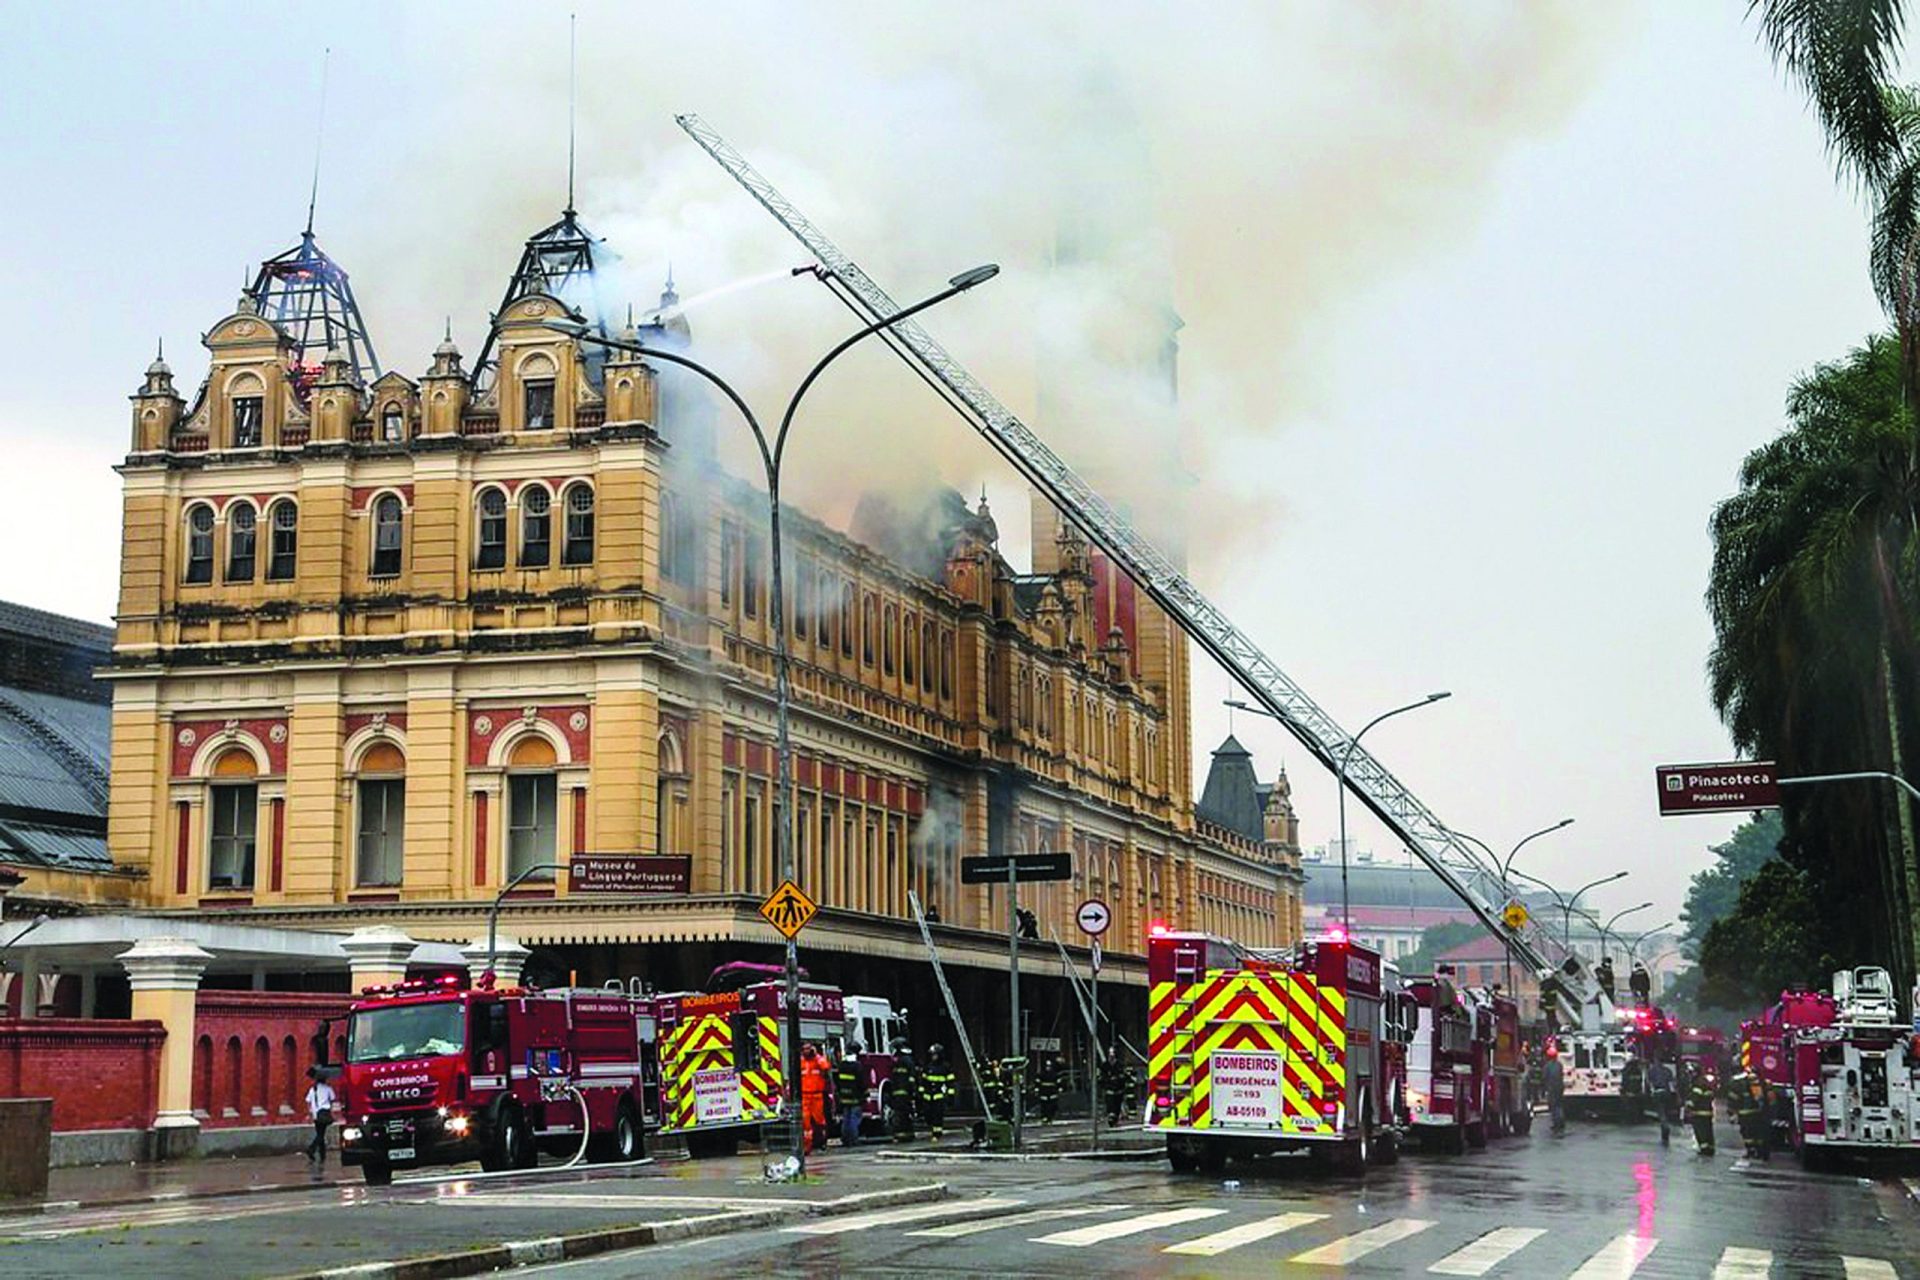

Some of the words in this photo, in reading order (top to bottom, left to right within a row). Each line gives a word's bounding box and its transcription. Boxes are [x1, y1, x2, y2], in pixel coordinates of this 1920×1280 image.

[1689, 774, 1770, 787] Pinacoteca
[1692, 792, 1745, 802] Pinacoteca
[589, 861, 621, 870] Museu
[624, 861, 636, 870] da
[625, 872, 684, 883] Portuguesa
[682, 991, 741, 1008] BOMBEIROS
[777, 990, 824, 1013] BOEIROS
[1214, 1056, 1279, 1071] BOMBEIROS
[1214, 1075, 1278, 1087] EMERGÊNCIA
[380, 1087, 421, 1099] IVECO
[1244, 1089, 1261, 1099] 193
